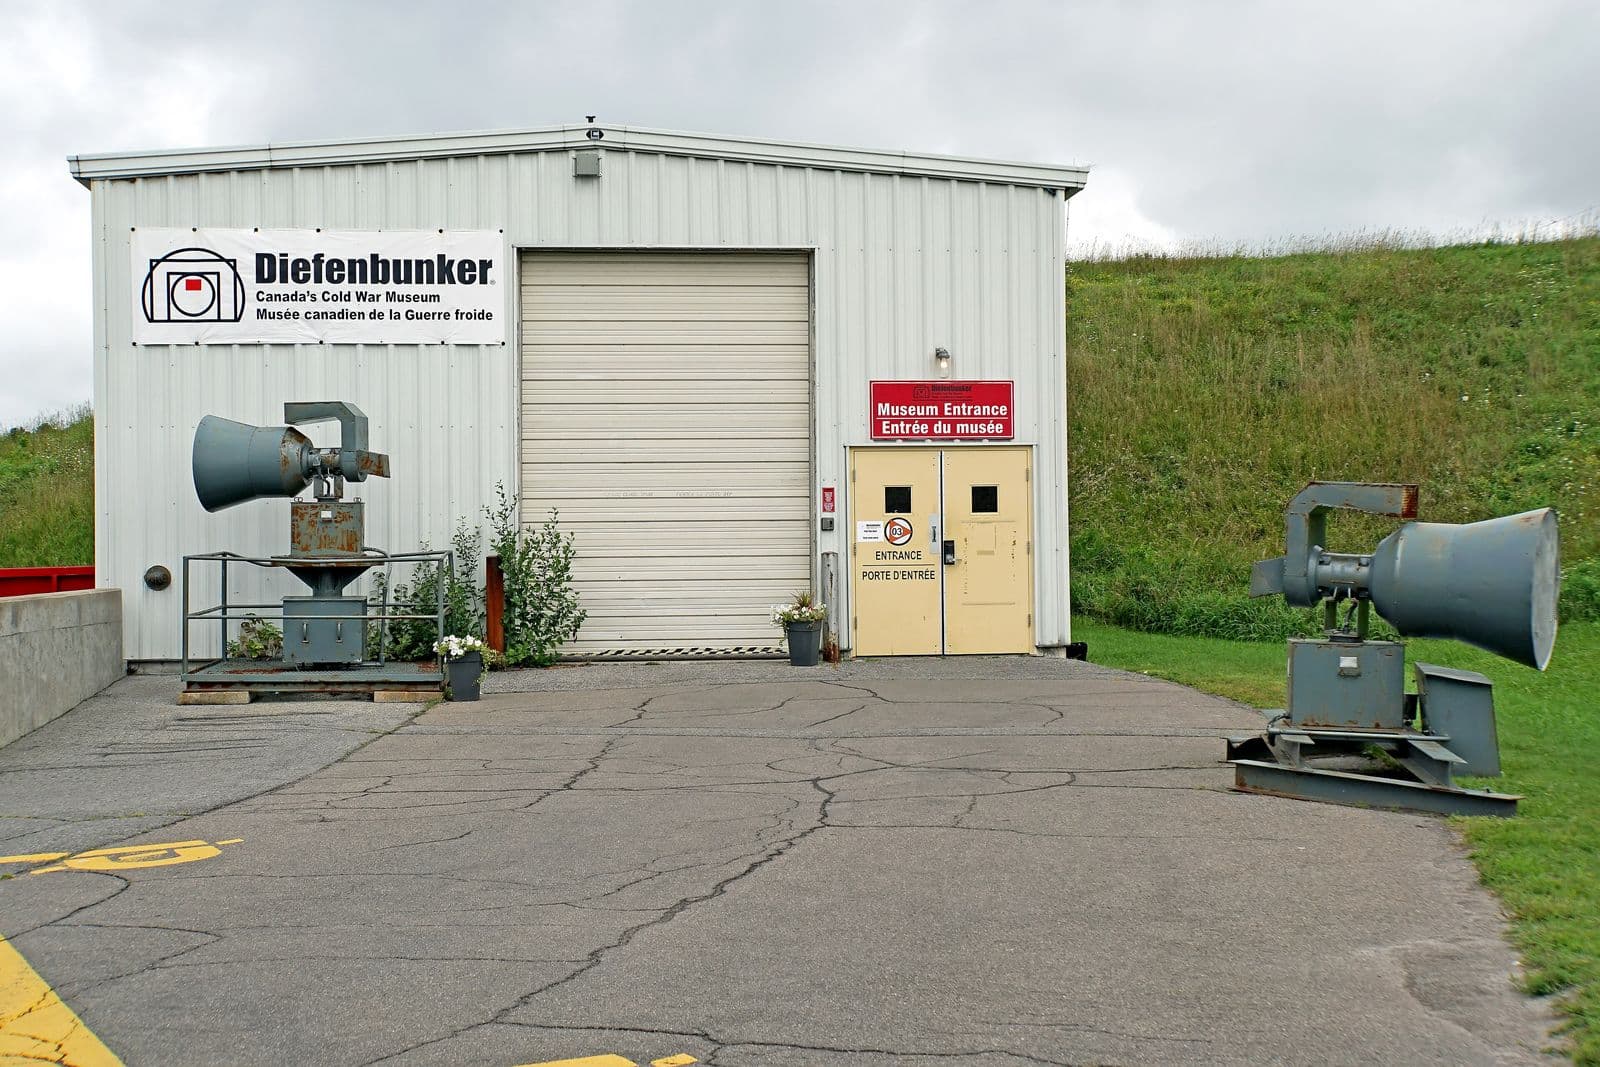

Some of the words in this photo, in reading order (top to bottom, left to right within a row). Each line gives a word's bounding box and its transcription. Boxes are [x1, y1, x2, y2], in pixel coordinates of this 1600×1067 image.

[255, 252, 493, 285] Diefenbunker
[256, 290, 317, 302] Canada's
[321, 290, 351, 302] Cold
[355, 290, 381, 302] War
[385, 290, 441, 302] Museum
[256, 307, 300, 320] Musée
[304, 308, 366, 320] canadien
[368, 308, 385, 320] de
[389, 308, 401, 320] la
[404, 309, 451, 321] Guerre
[454, 308, 493, 321] froide
[877, 402, 939, 416] Museum
[943, 402, 1008, 416] Entrance
[882, 420, 929, 434] Entrée
[933, 420, 952, 434] du
[956, 420, 1004, 434] musée
[891, 527, 903, 536] 03
[875, 550, 922, 561] ENTRANCE
[862, 570, 891, 581] PORTE
[893, 568, 936, 580] D'ENTRÉE
